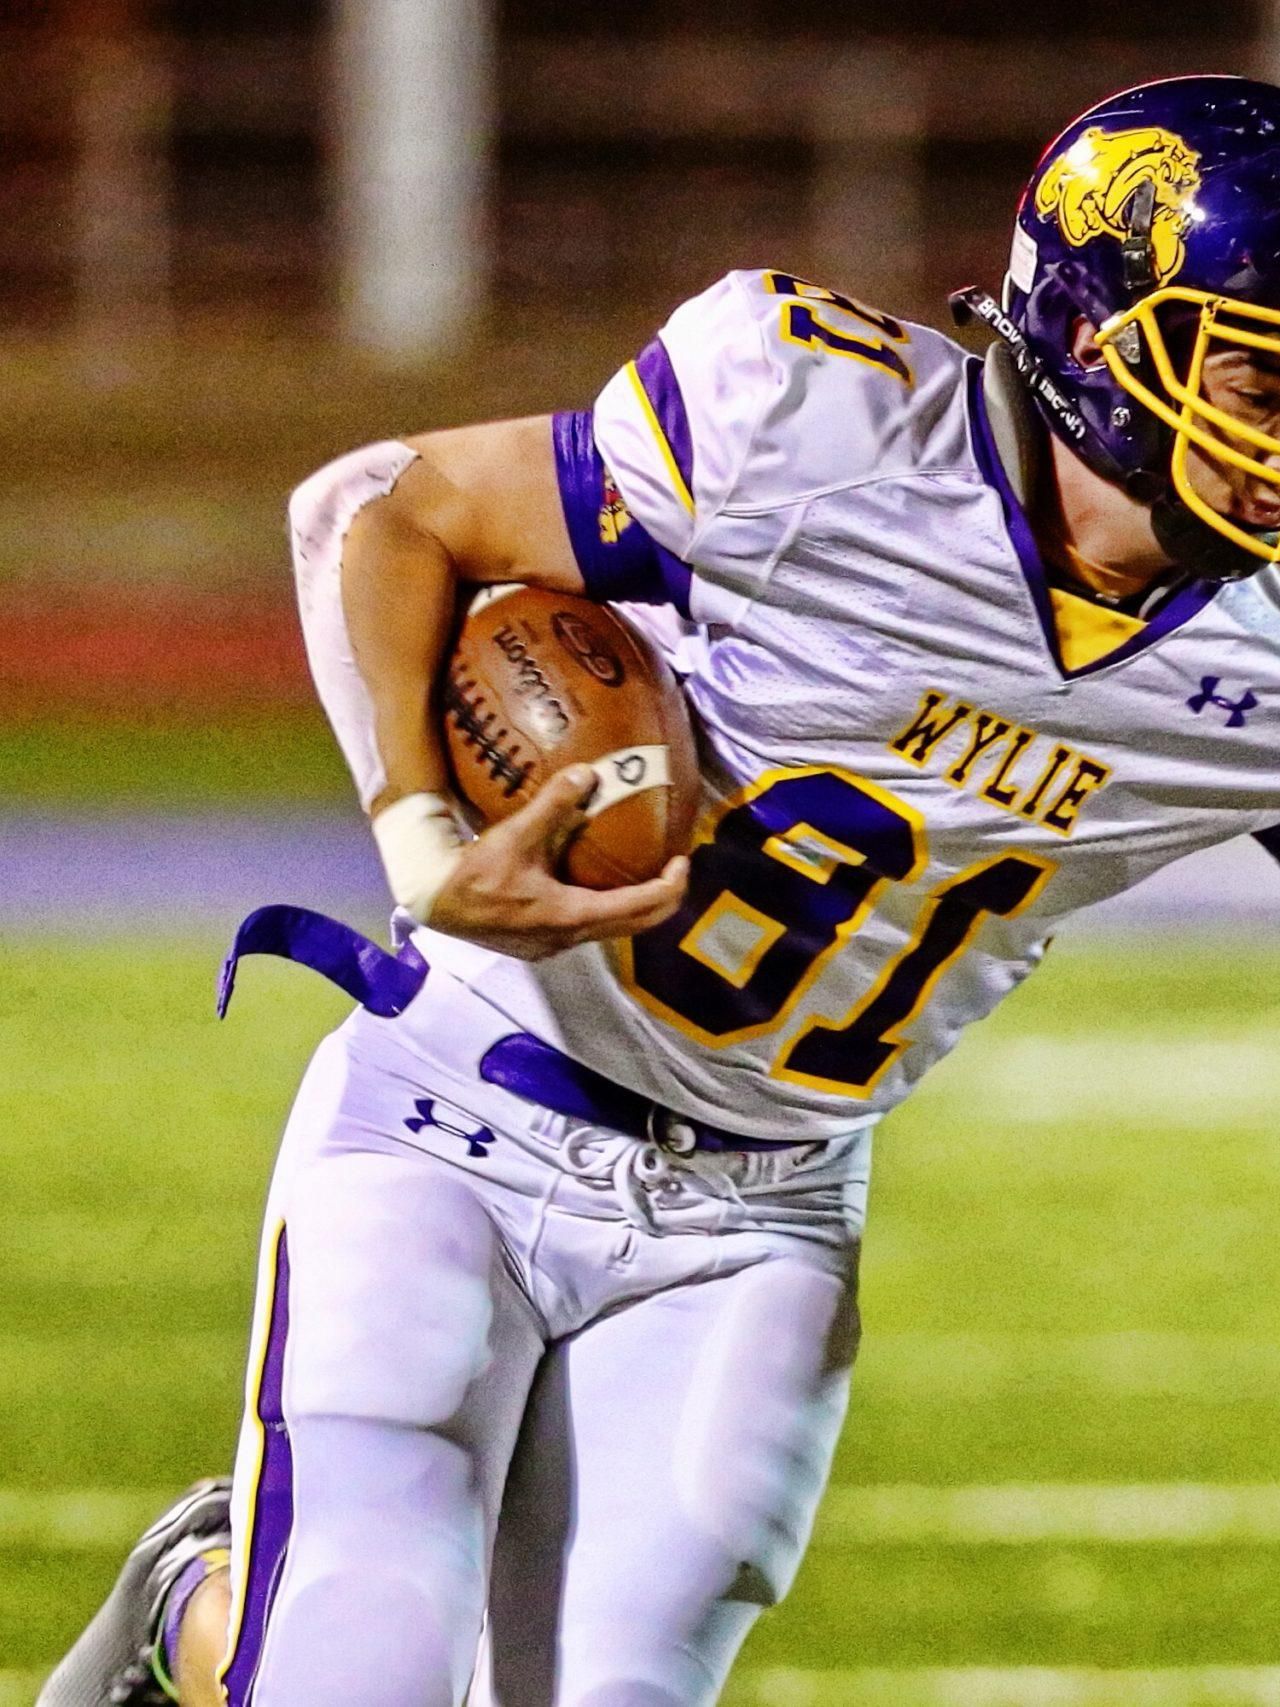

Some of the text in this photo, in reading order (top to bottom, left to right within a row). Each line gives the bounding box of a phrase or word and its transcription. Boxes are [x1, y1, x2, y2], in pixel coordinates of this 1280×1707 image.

[977, 297, 1029, 373] AMOUR
[887, 687, 1111, 838] WYLIE
[620, 764, 1060, 1099] 81
